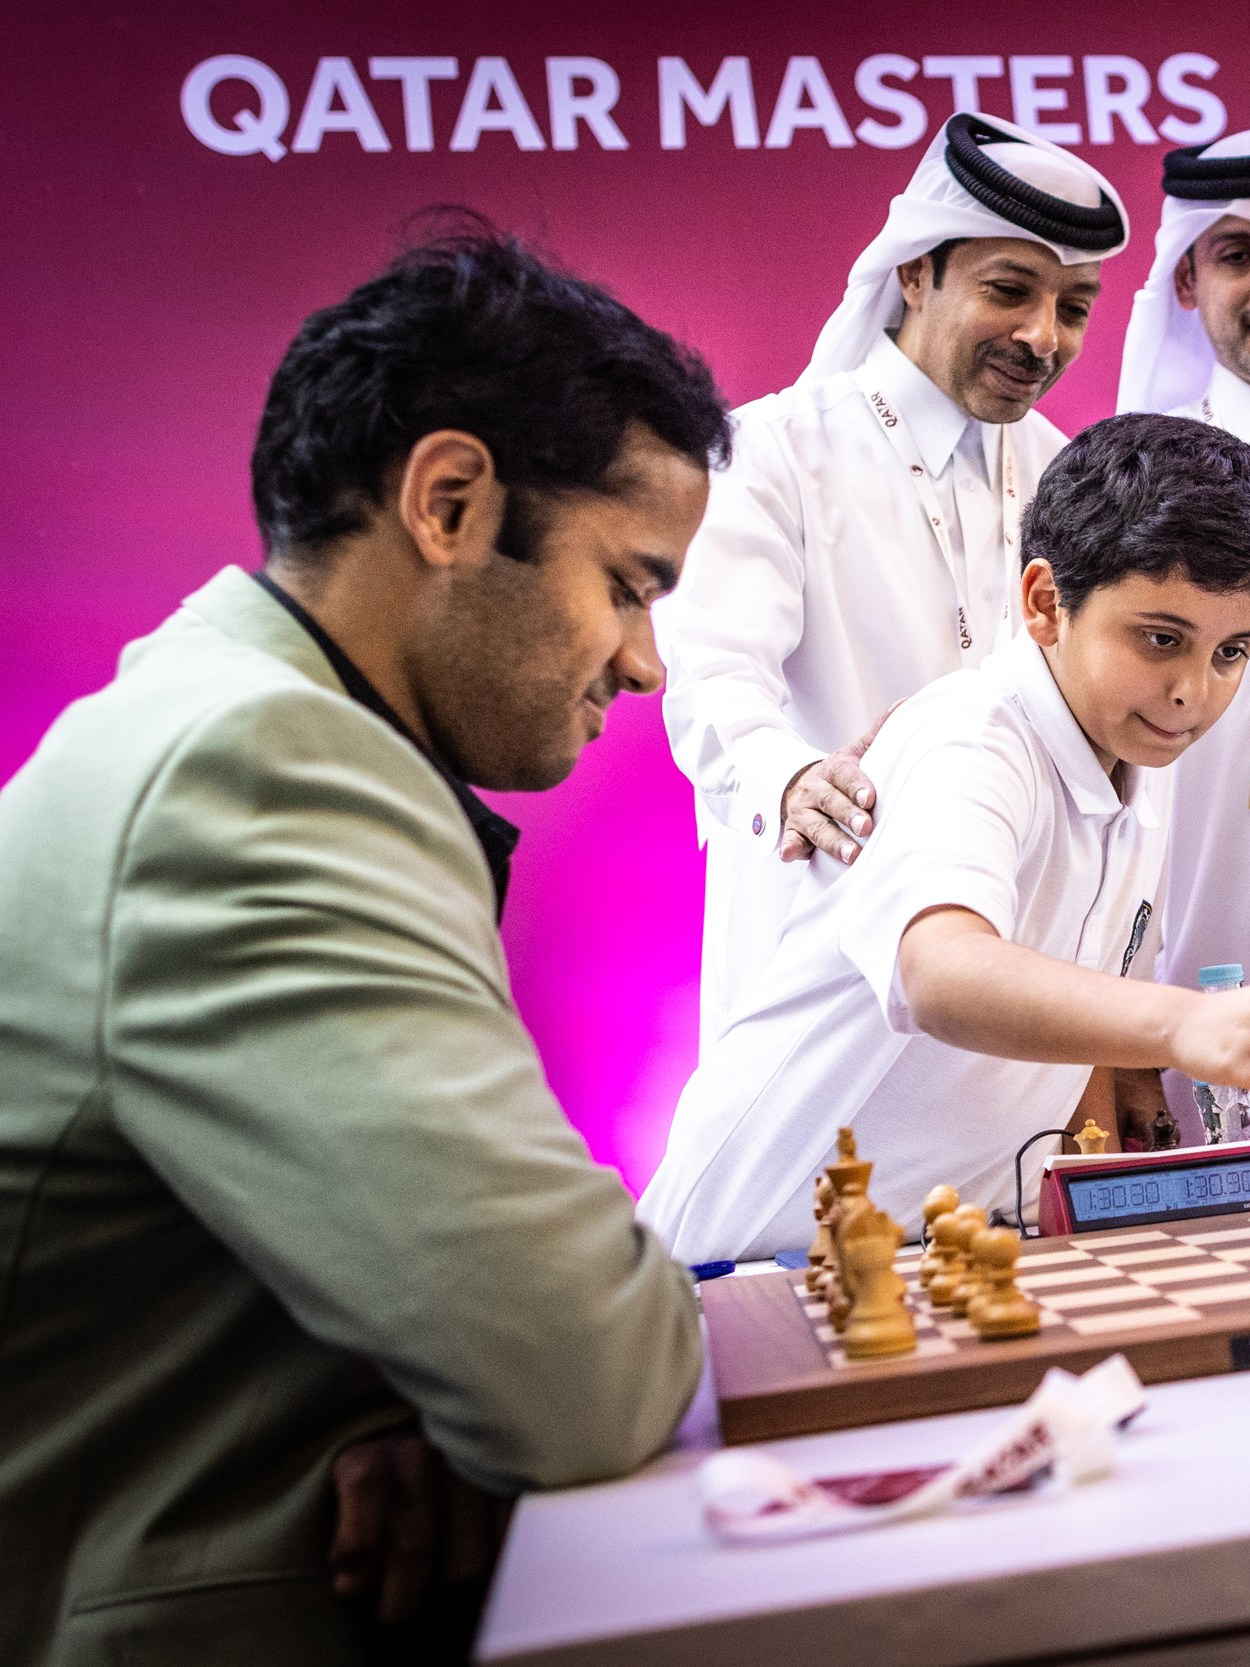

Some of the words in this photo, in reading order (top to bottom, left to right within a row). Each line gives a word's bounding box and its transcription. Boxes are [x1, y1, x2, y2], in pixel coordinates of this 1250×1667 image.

[180, 54, 629, 163] QATAR
[657, 52, 1227, 150] MASTERS
[871, 391, 898, 427] QATAR
